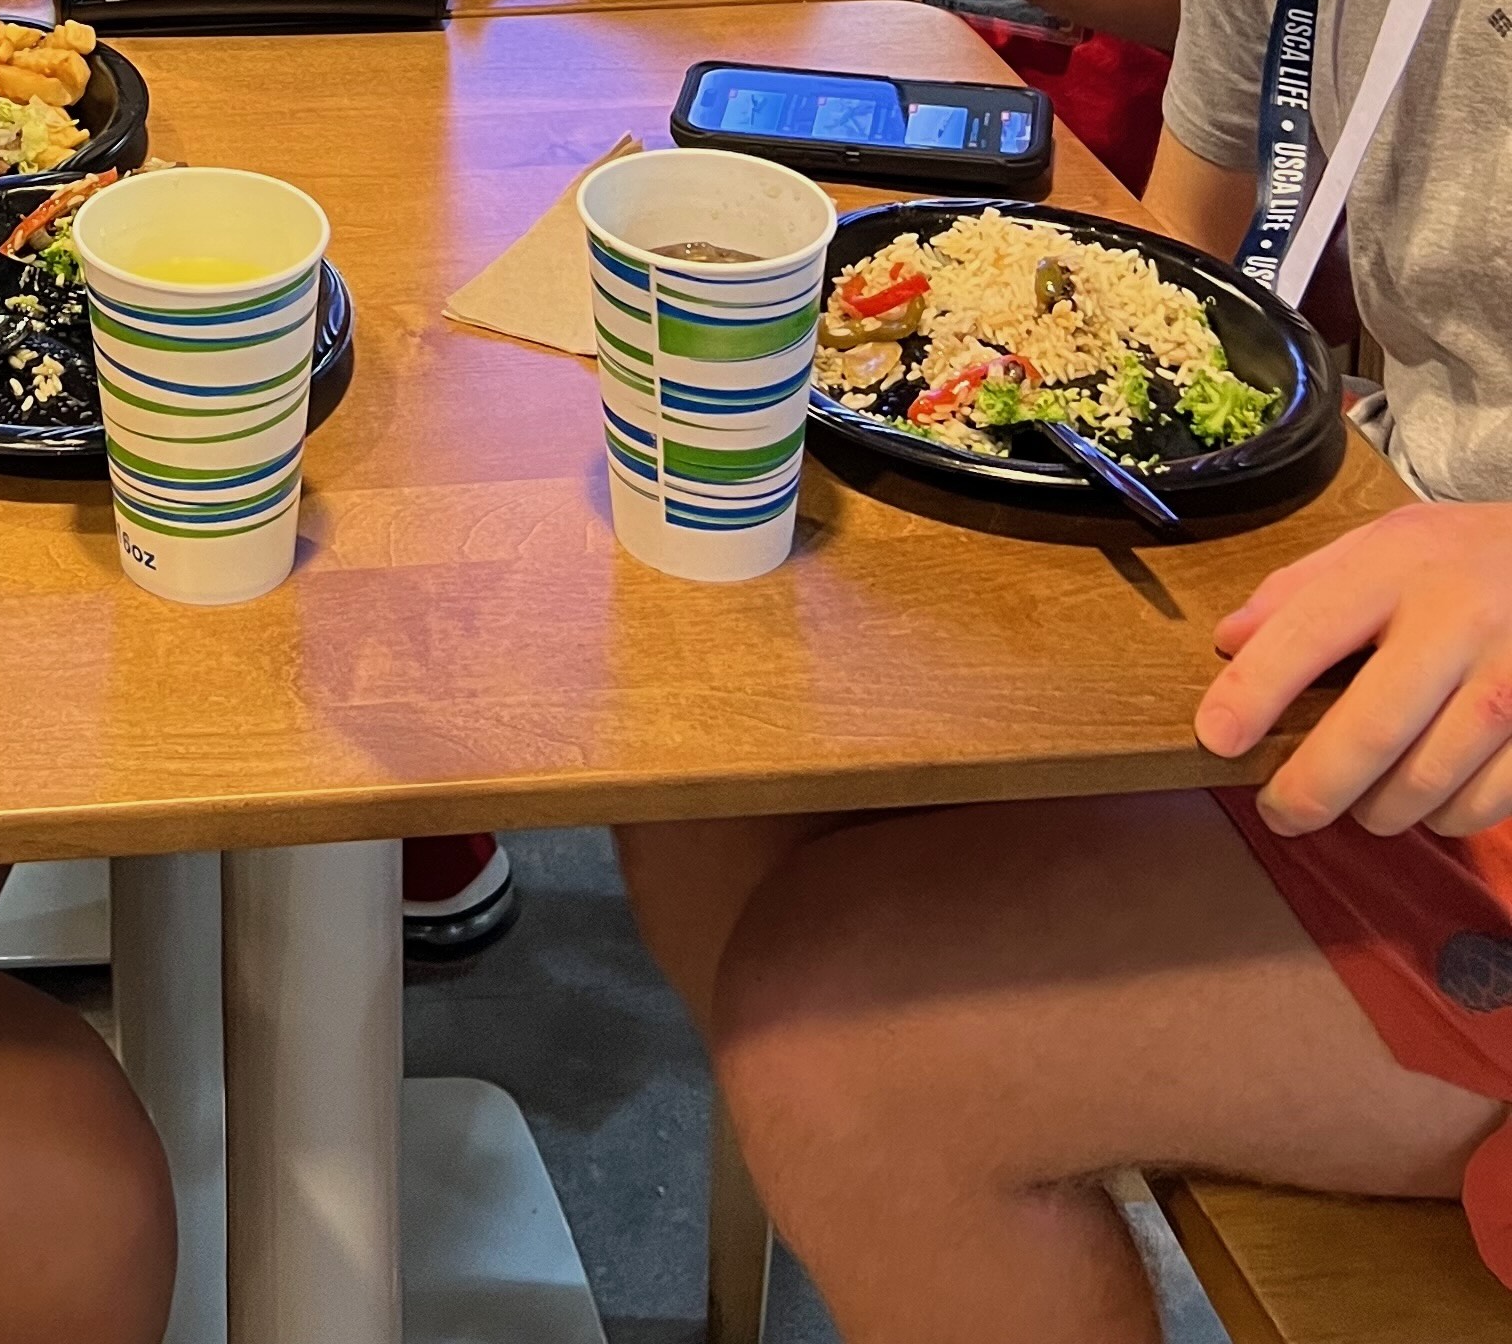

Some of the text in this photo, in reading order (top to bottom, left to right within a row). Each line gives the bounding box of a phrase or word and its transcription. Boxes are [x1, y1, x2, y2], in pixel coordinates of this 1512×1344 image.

[1276, 8, 1315, 110] USCA LIFE
[1262, 142, 1307, 231] USCA LIFE
